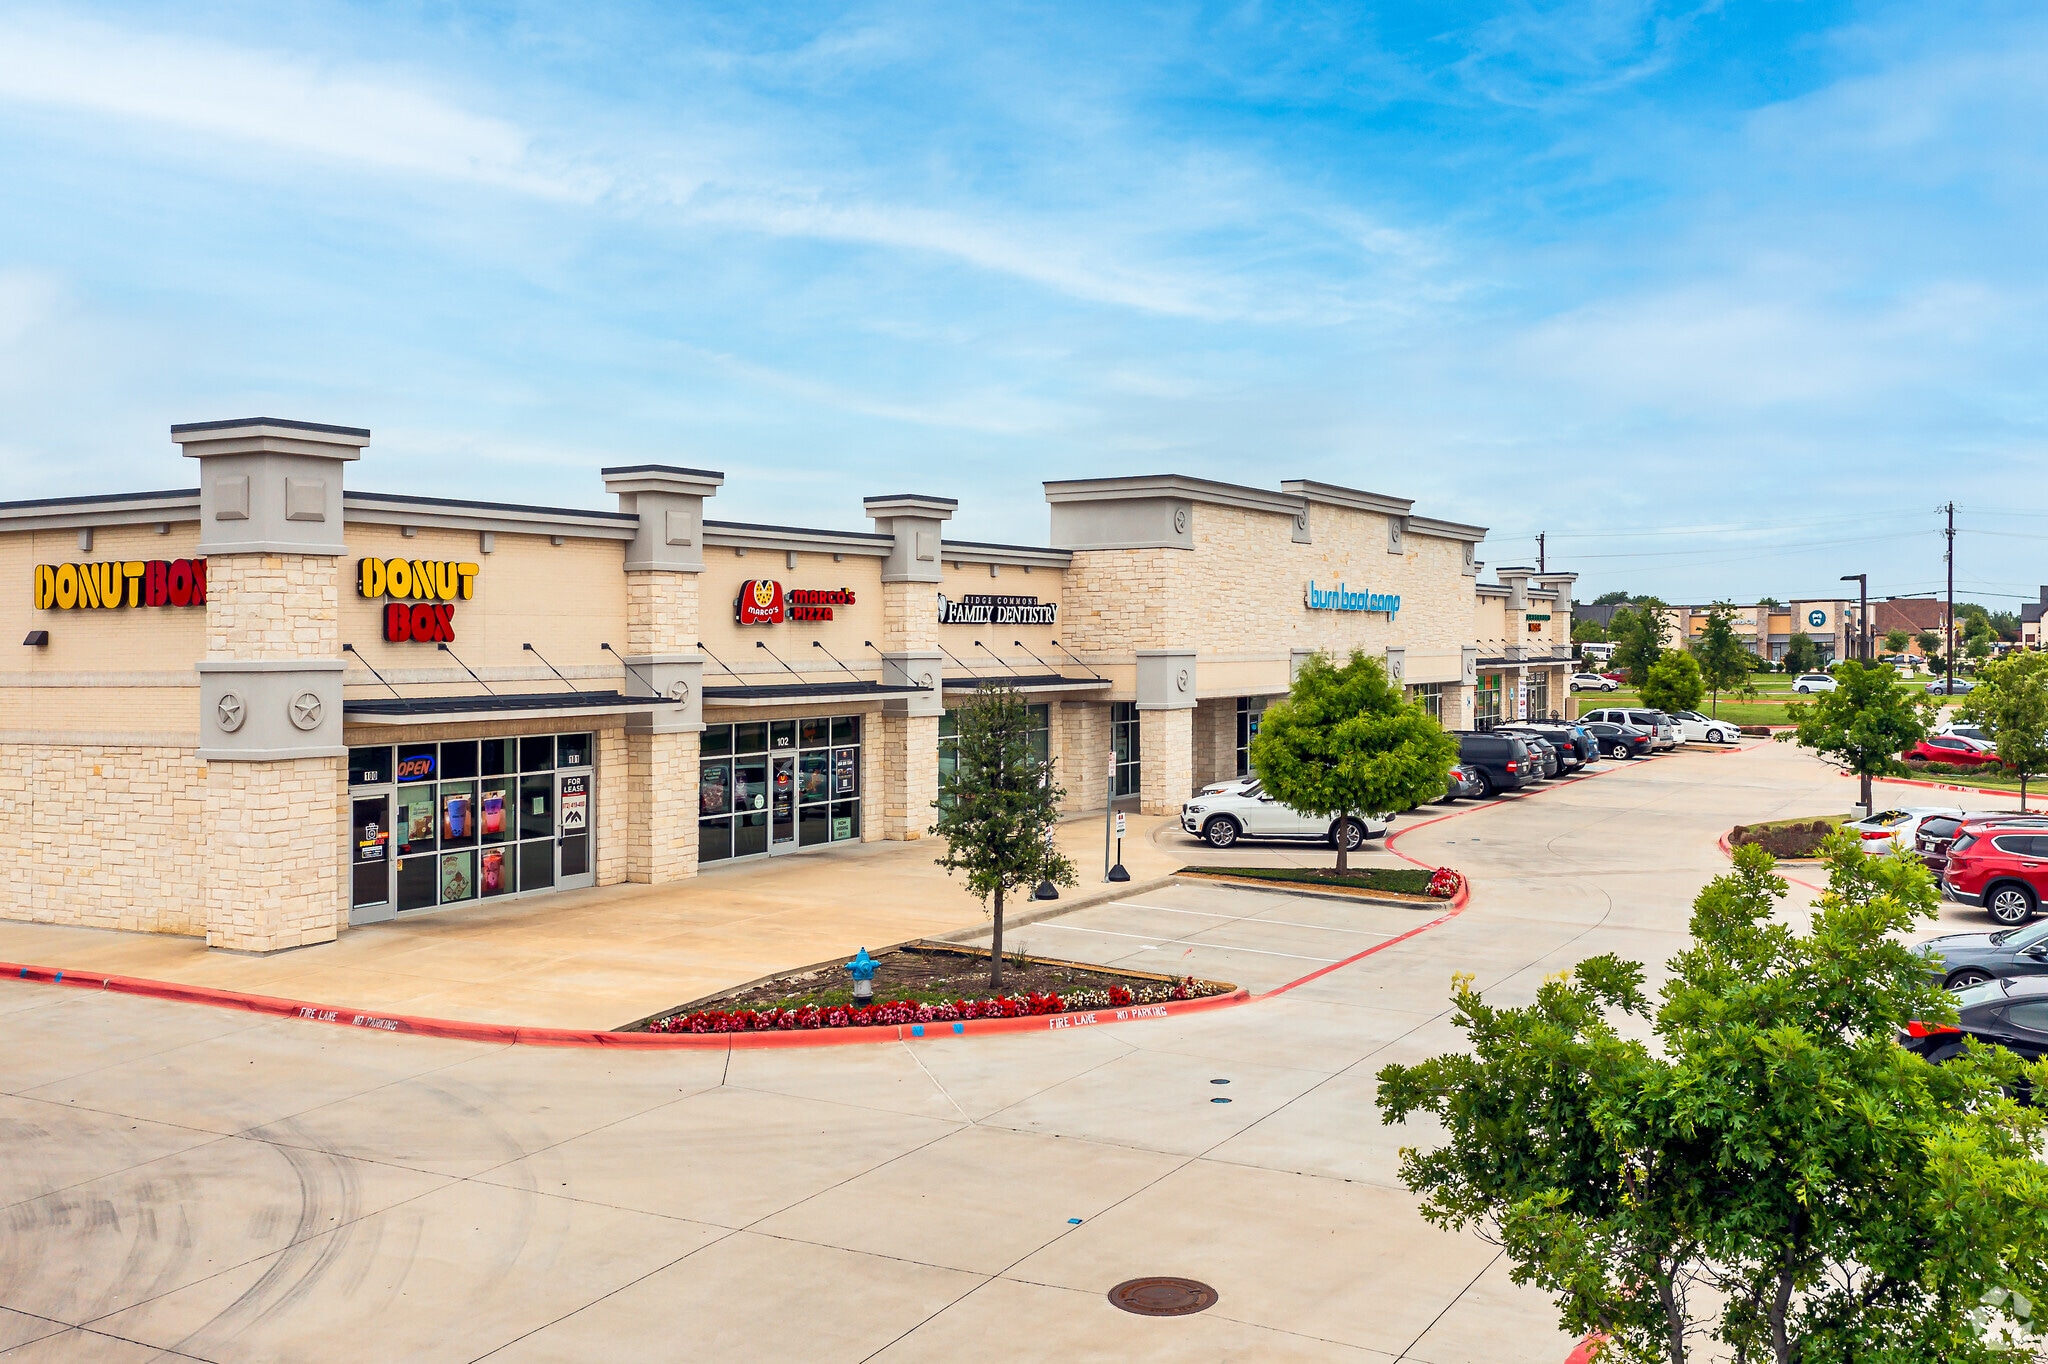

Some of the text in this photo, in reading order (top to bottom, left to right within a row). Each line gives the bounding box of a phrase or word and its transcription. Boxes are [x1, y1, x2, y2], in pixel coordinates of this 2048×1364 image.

[359, 557, 480, 600] DONUT
[794, 587, 856, 605] MARCO'S
[964, 596, 1038, 605] RIDGE COMMONS
[1309, 580, 1401, 622] burn boot camp
[747, 605, 779, 616] MARCO'S
[794, 607, 834, 621] PIZZA
[947, 602, 1060, 623] FAMILY DENTISTRY
[385, 603, 456, 642] BOX
[777, 737, 789, 746] 102
[398, 760, 431, 776] OPEN
[563, 785, 584, 793] LEASE
[567, 777, 581, 786] FOR
[299, 1007, 398, 1031] FIRE LANE NO PARKING
[1049, 1006, 1168, 1030] FIRE LANE NO PARKING
